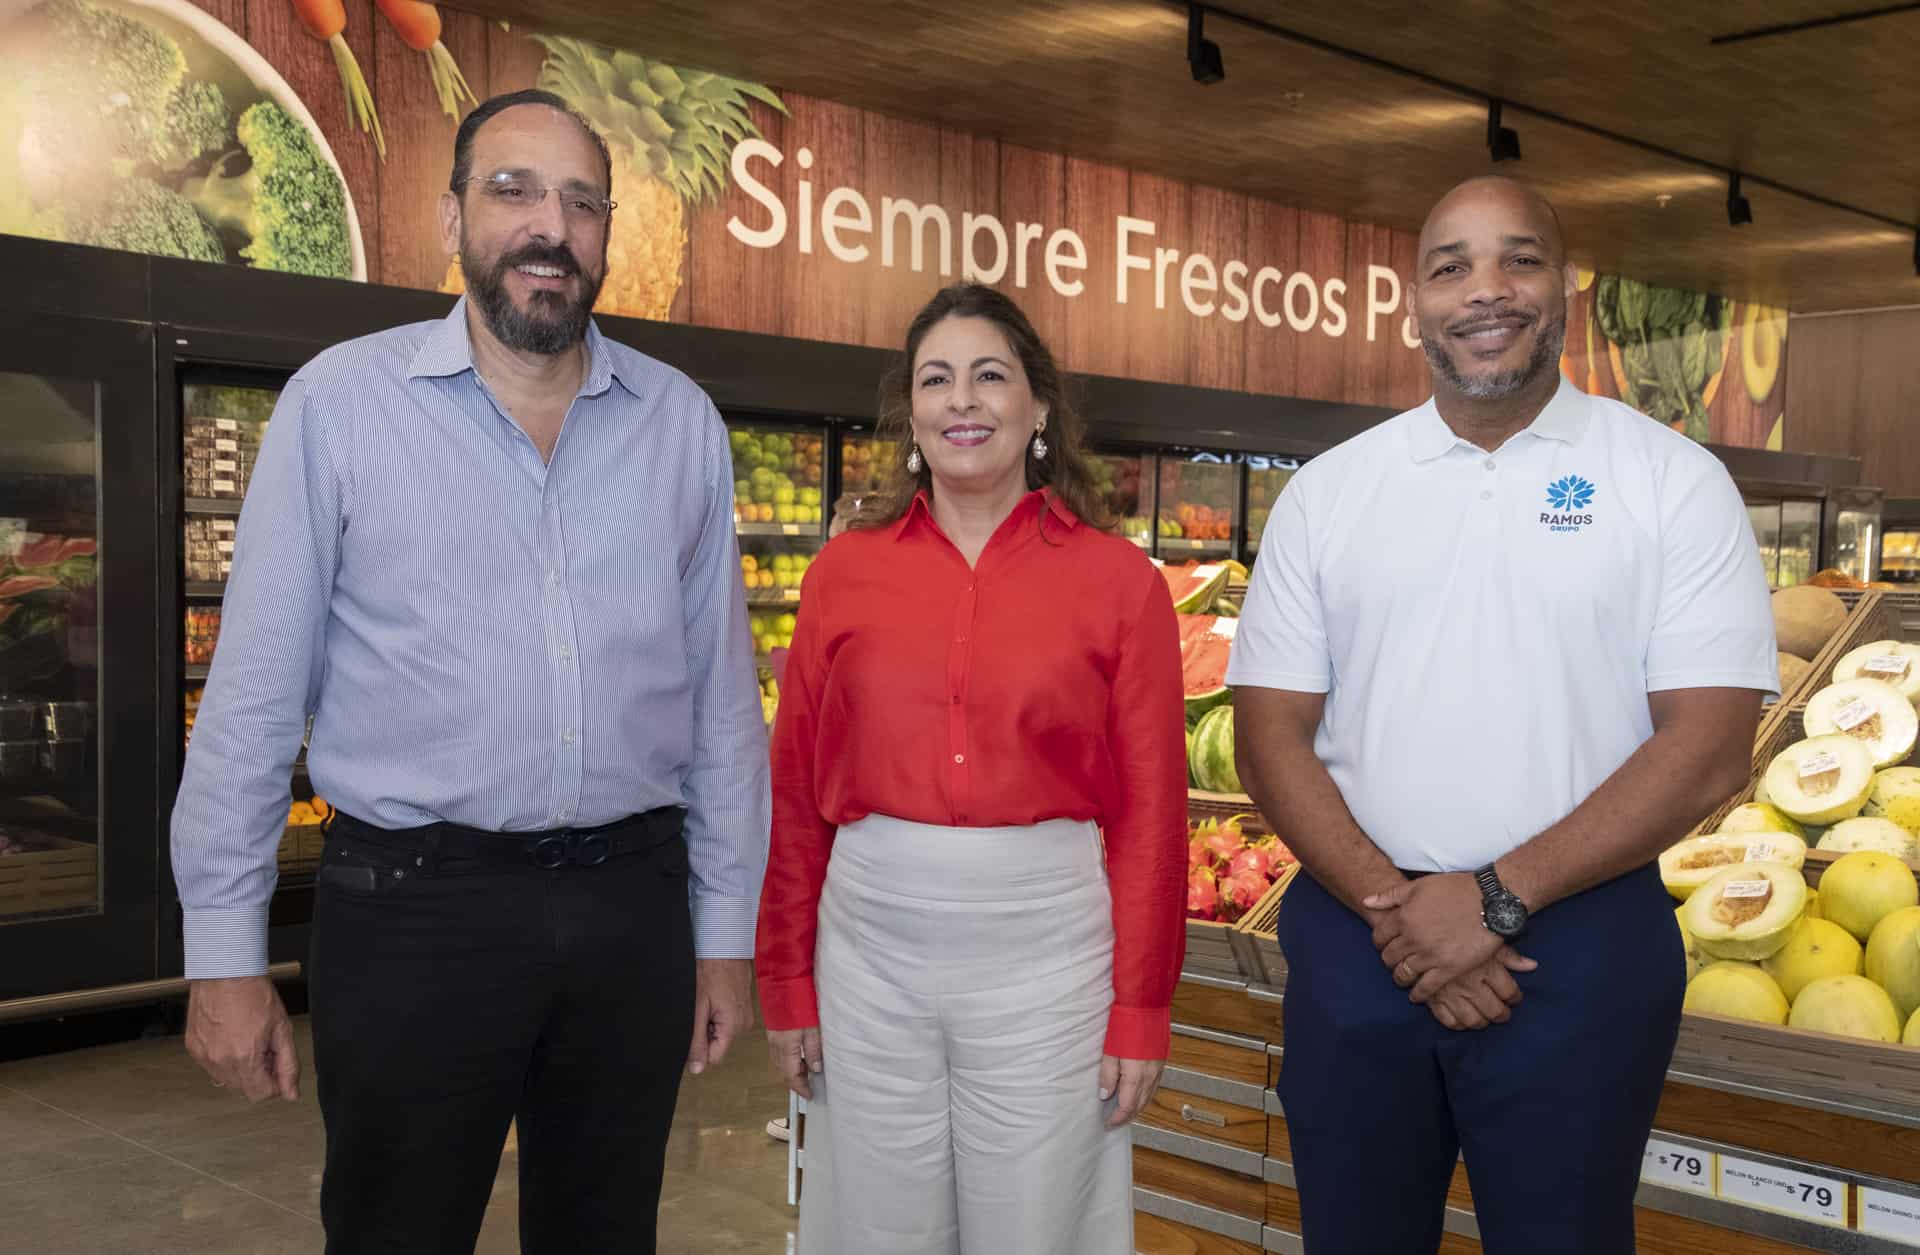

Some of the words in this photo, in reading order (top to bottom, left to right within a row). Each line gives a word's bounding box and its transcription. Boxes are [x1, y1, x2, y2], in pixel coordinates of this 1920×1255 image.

[726, 138, 1087, 296] Siempre
[1116, 216, 1347, 335] Frescos
[1540, 513, 1592, 525] RAMOS
